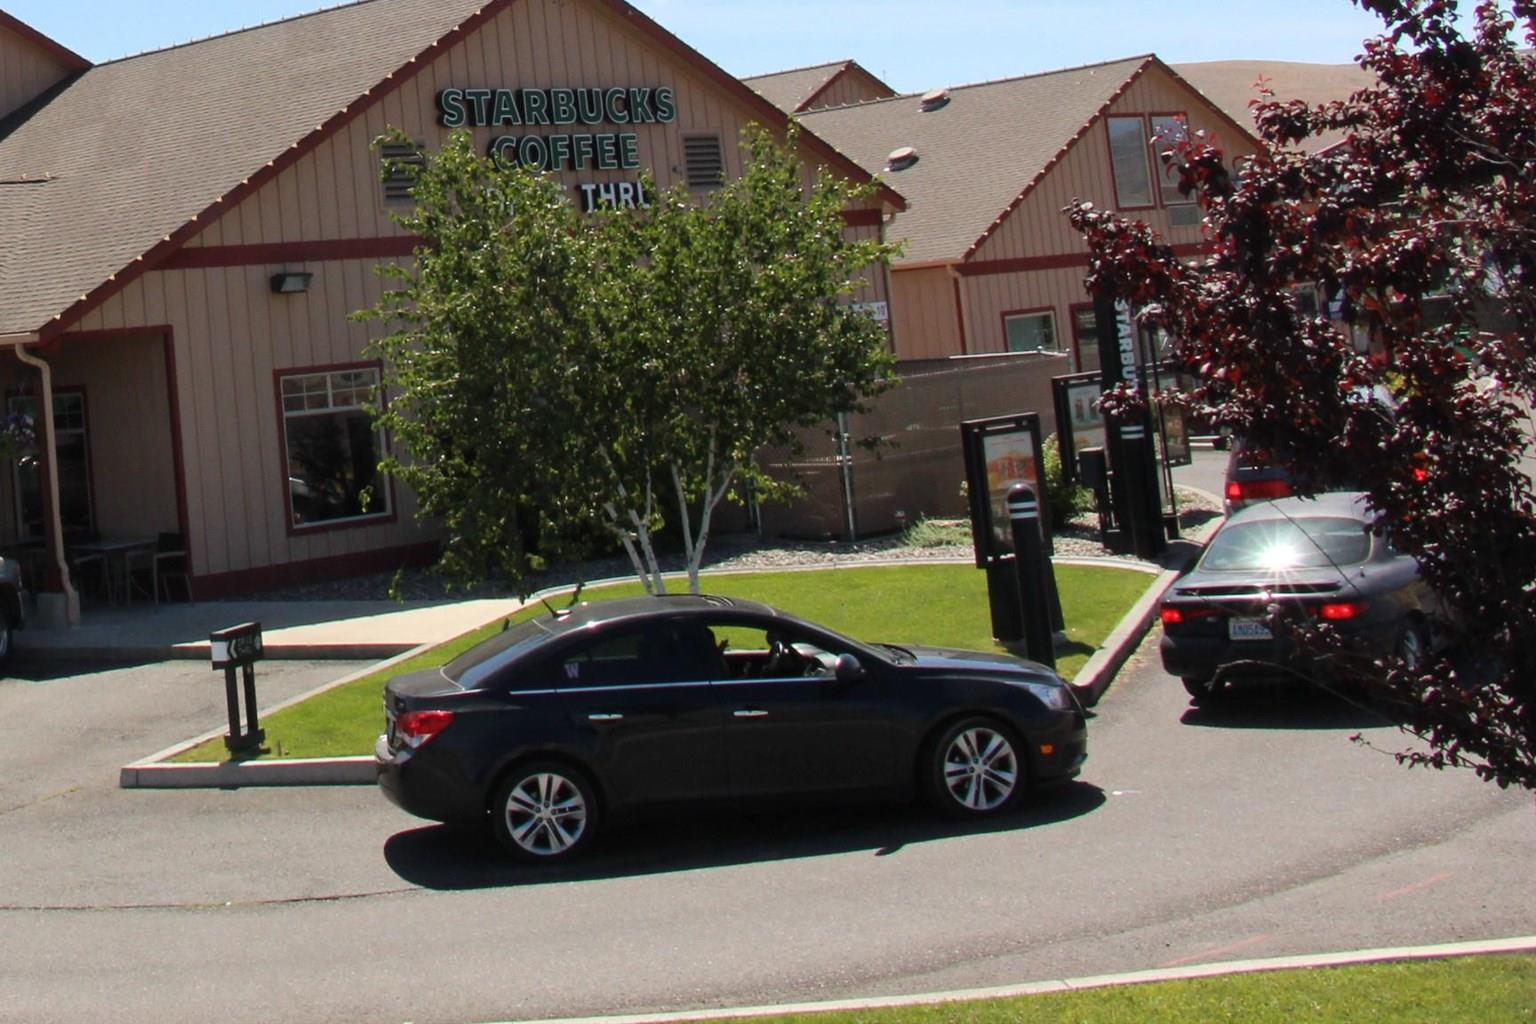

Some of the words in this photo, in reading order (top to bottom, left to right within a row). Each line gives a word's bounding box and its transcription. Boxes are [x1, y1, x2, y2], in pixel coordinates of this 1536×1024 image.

[440, 87, 677, 127] STARBUCKS
[493, 133, 641, 173] COFFEE
[1113, 298, 1138, 386] STARBU
